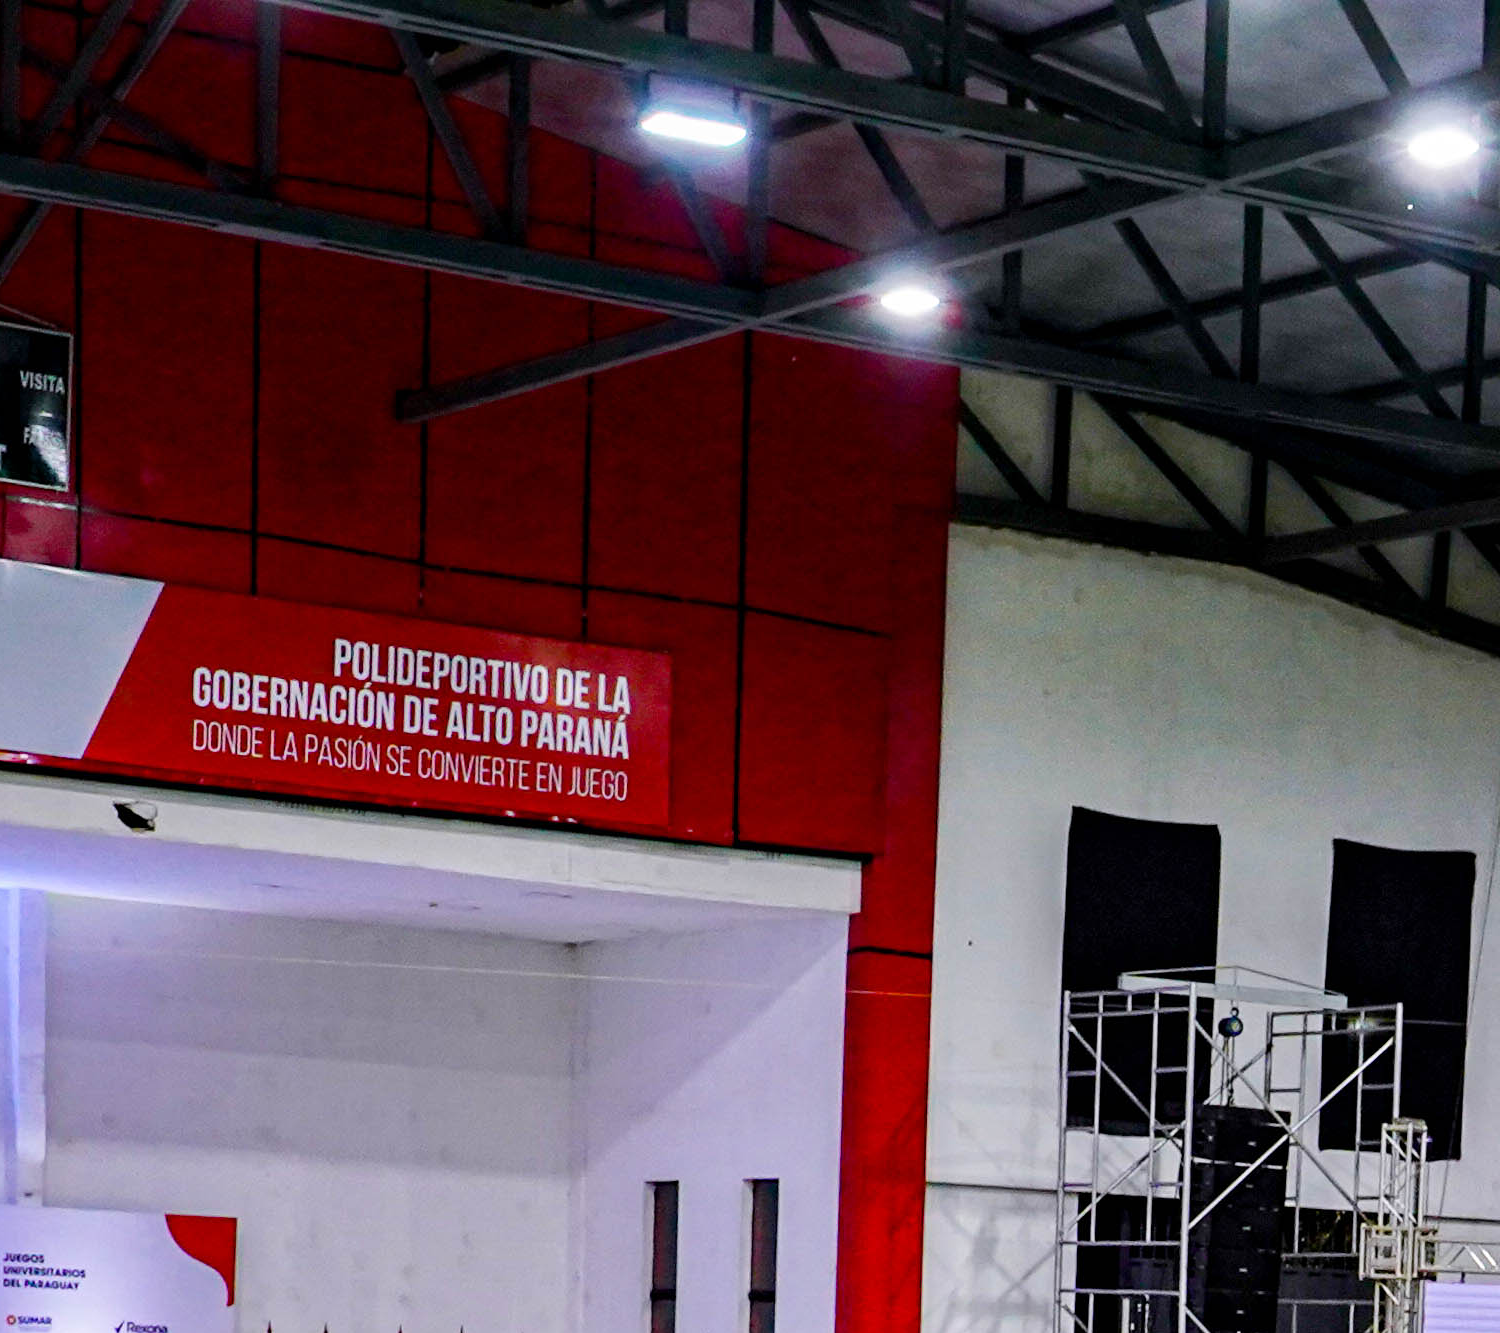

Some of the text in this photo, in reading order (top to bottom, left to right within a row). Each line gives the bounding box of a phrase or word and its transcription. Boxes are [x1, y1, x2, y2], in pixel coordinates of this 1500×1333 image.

[20, 370, 65, 394] VISITA
[333, 637, 632, 714] POLIDEPORTIVO DE LA
[192, 667, 629, 760] GOBERNACIÓN DE ALTO PARANÁ
[192, 719, 628, 801] DONDE LA PASIÓN SE CONVIERTE EN JUEGO
[3, 1253, 46, 1264] JUEGOS
[3, 1265, 87, 1280] UNIVERSITARIOS
[3, 1278, 80, 1291] DEL PARAGUAY
[17, 1316, 52, 1325] SUMAR
